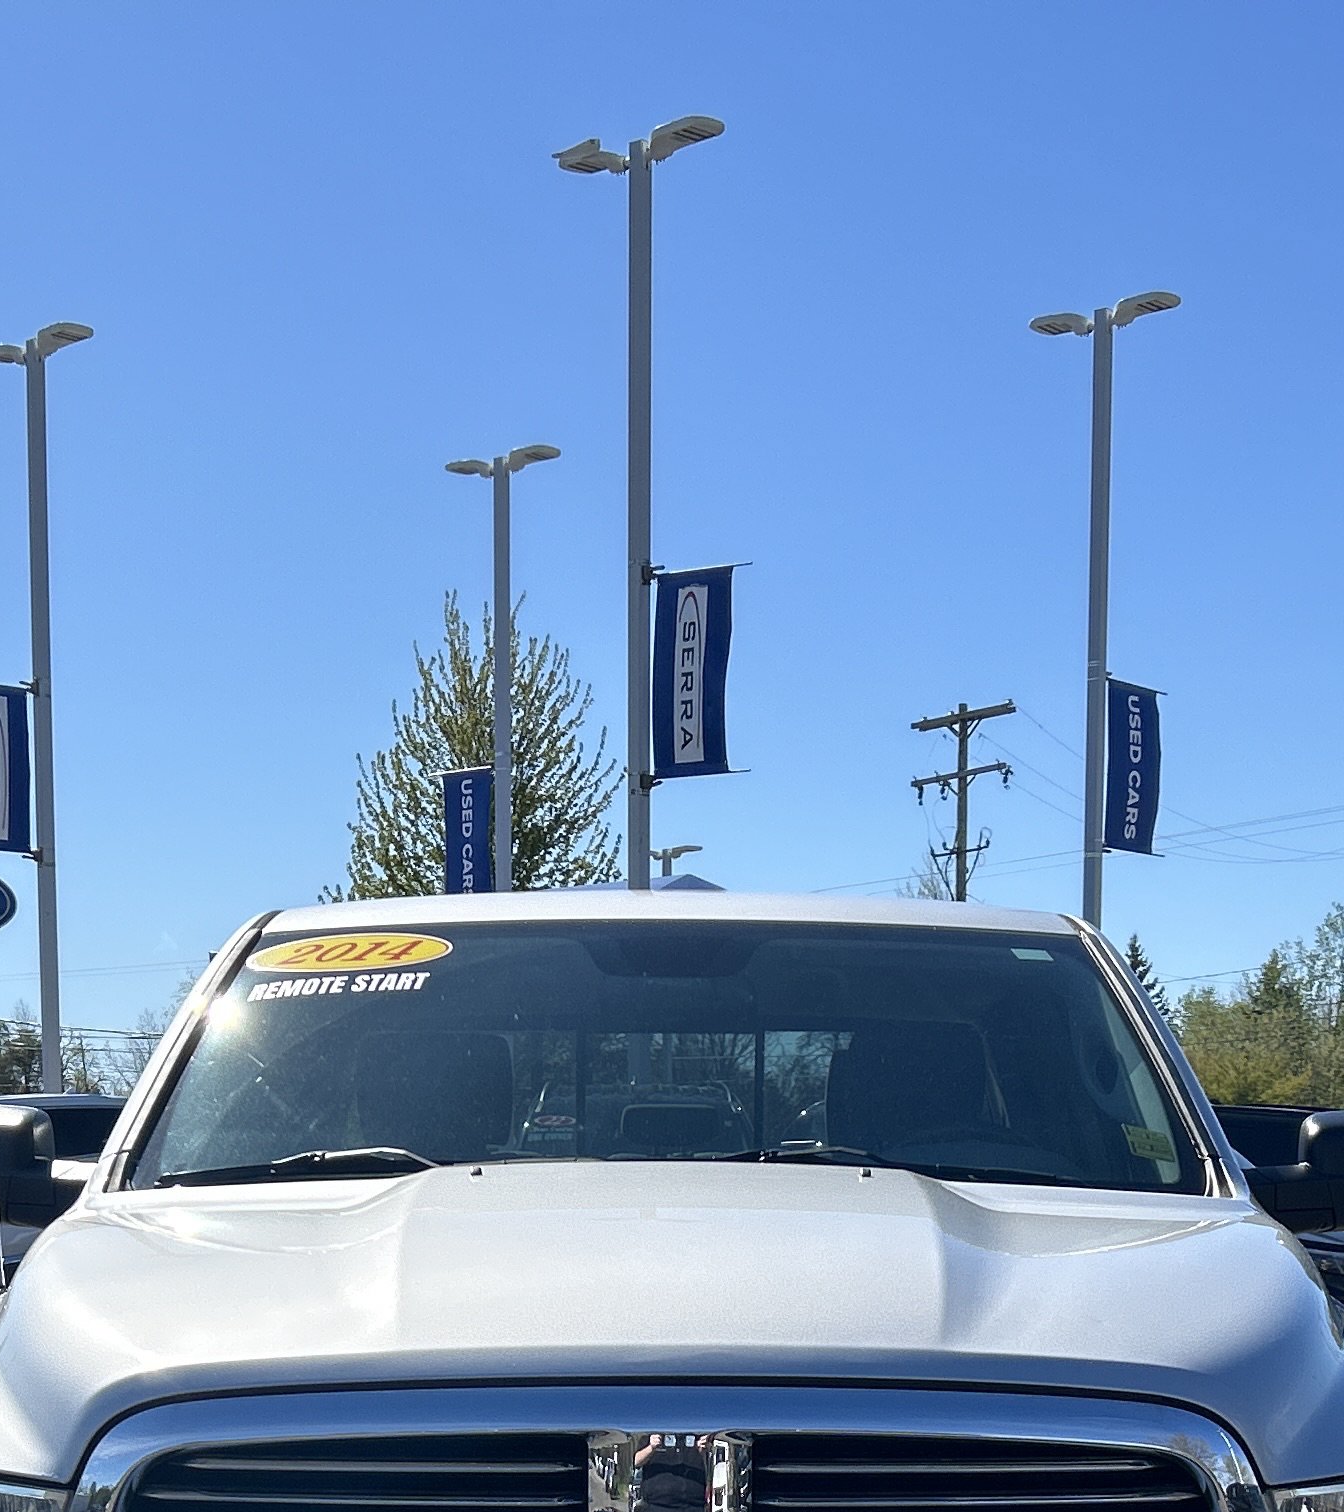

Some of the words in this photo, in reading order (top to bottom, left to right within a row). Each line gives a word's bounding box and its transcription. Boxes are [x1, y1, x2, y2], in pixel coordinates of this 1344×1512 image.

[680, 621, 697, 750] SERRA
[1127, 694, 1142, 764] USED
[461, 779, 473, 838] USED
[1124, 770, 1142, 840] CARS
[462, 843, 474, 894] CAR
[276, 940, 424, 966] 2014
[247, 975, 349, 1002] REMOTE
[351, 972, 431, 992] START
